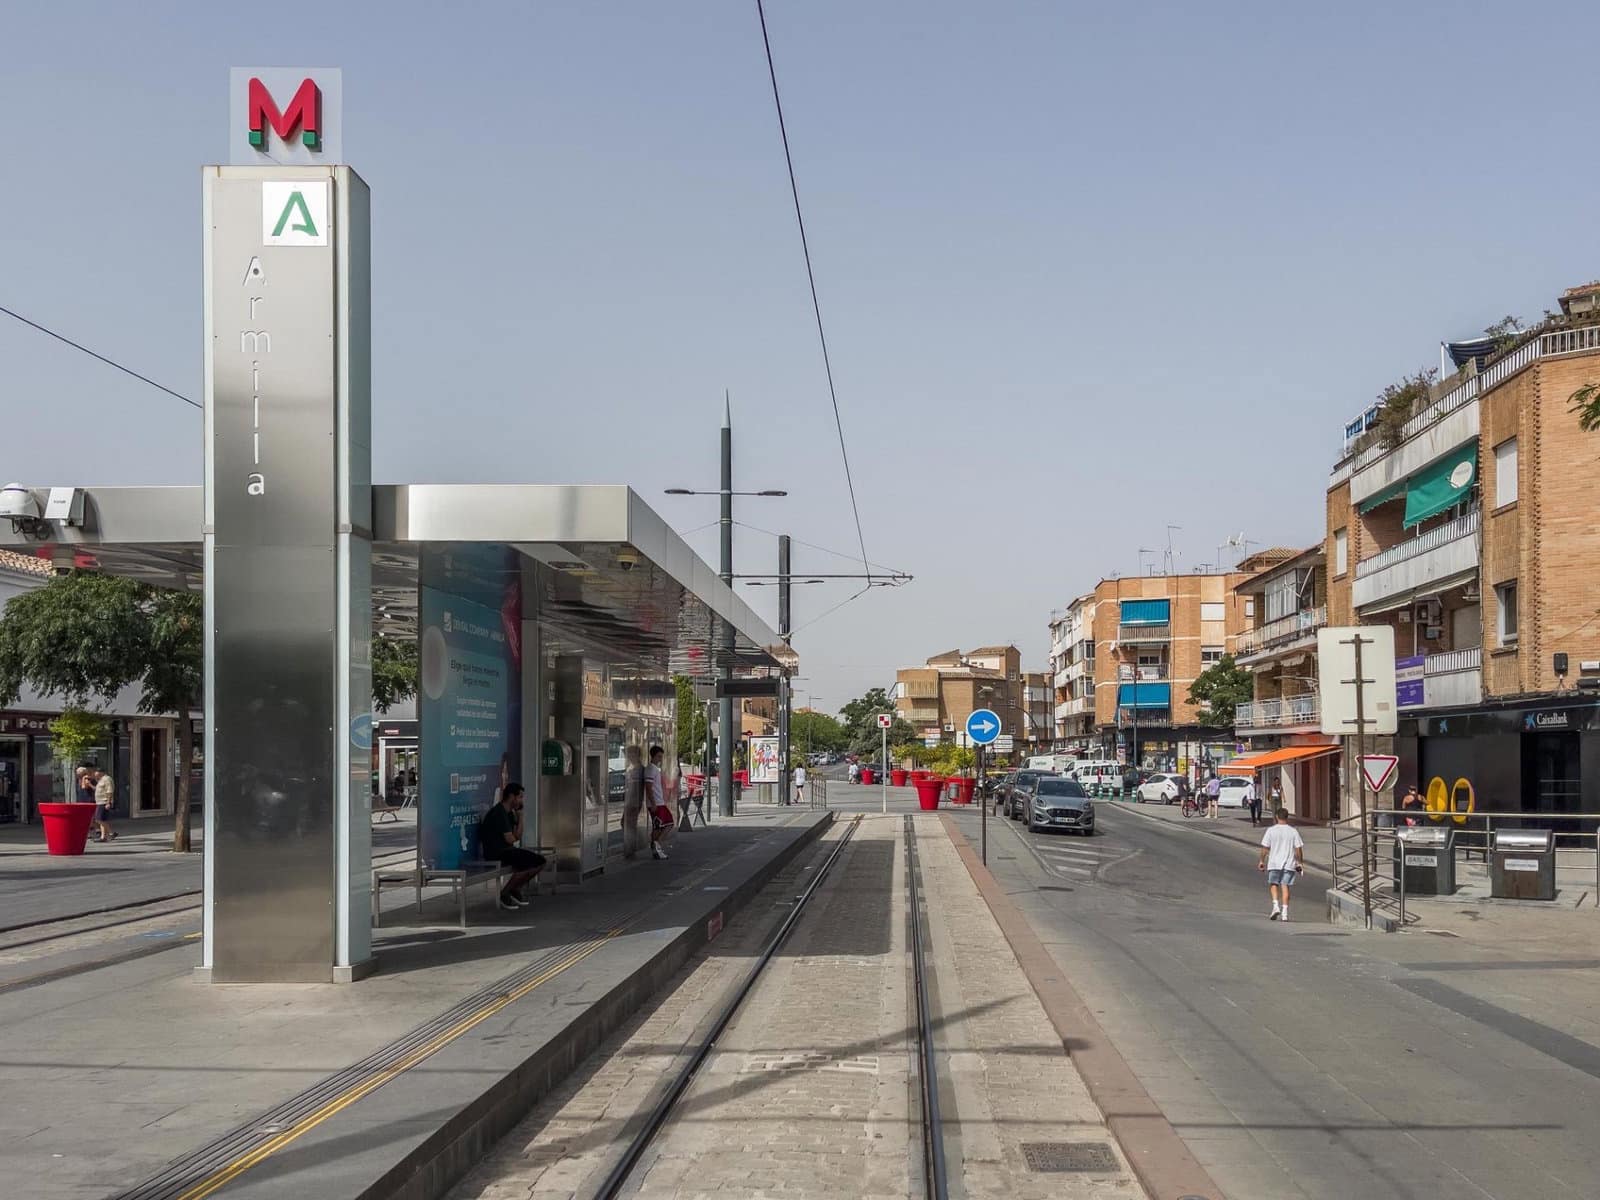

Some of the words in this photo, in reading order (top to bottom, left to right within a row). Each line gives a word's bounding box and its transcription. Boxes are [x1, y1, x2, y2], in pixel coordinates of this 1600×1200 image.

[248, 77, 320, 147] M
[240, 255, 272, 496] Armilla
[1536, 712, 1568, 725] CaixaBank
